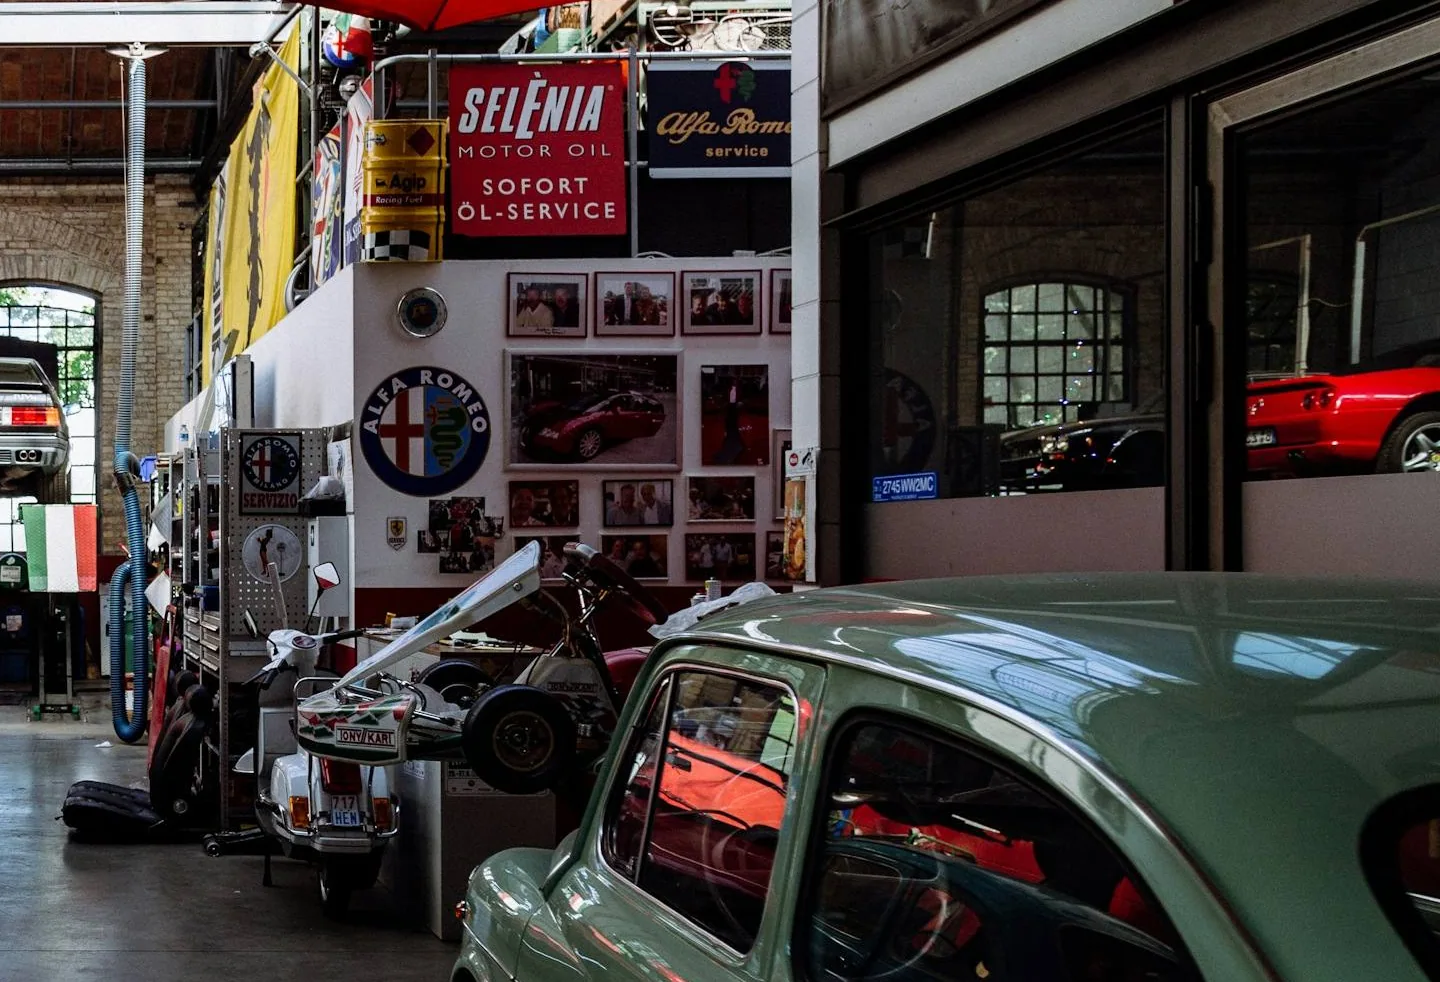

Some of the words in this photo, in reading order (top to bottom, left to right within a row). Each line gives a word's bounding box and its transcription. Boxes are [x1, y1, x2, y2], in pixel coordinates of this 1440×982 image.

[656, 111, 720, 144] Alfa
[458, 145, 552, 159] MOTOR
[568, 144, 611, 157] OIL
[705, 145, 769, 157] service
[389, 174, 426, 192] Agip
[482, 177, 588, 196] SOFORT
[457, 201, 615, 221] ÖL-SERVICE
[363, 377, 408, 436] ALFA
[420, 370, 488, 434] ROMEO
[243, 492, 298, 509] SERVIZIO
[335, 811, 357, 825] HEN
